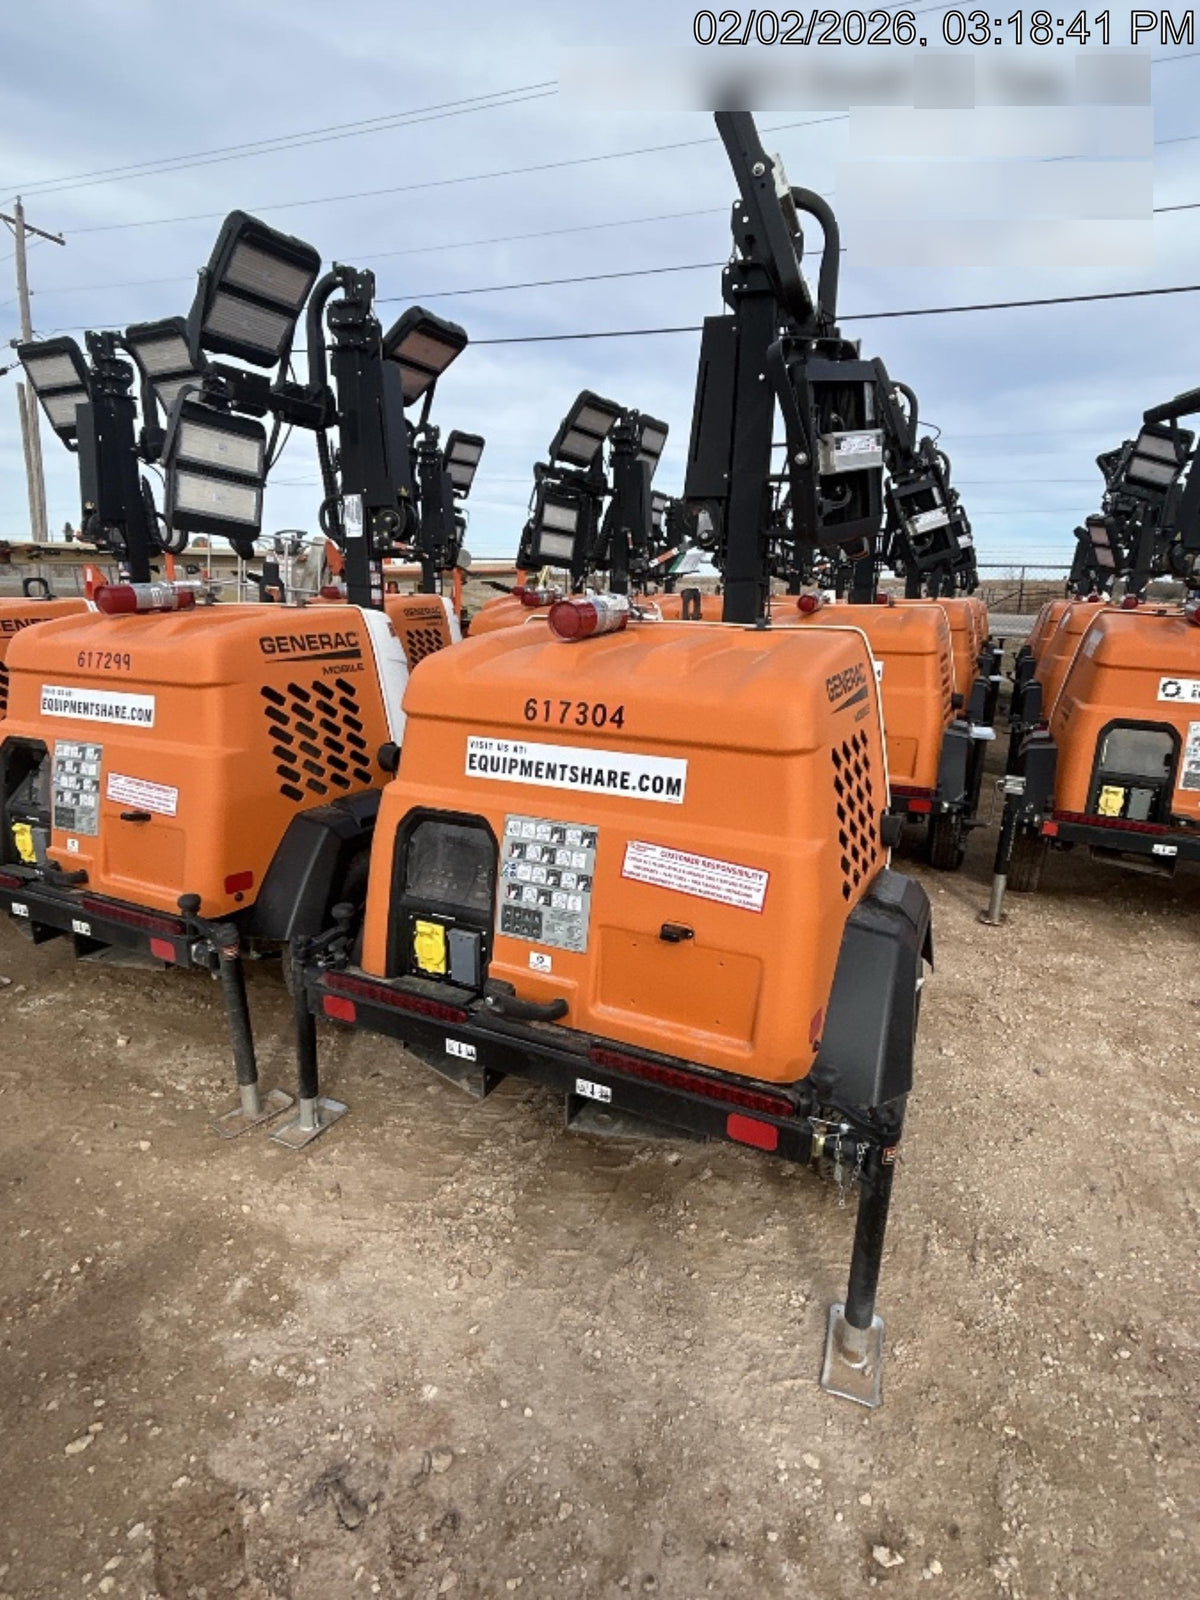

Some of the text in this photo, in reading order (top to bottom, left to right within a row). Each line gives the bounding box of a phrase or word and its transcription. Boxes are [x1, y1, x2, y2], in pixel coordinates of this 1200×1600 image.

[259, 631, 359, 654] GENERAC
[77, 651, 131, 670] 617299
[41, 697, 153, 723] EQUIPMENTSHARE.COM
[523, 698, 626, 729] 617304
[469, 739, 494, 751] VISIT
[497, 742, 510, 753] US
[468, 753, 683, 797] EQUIPMENTSHARE.COM
